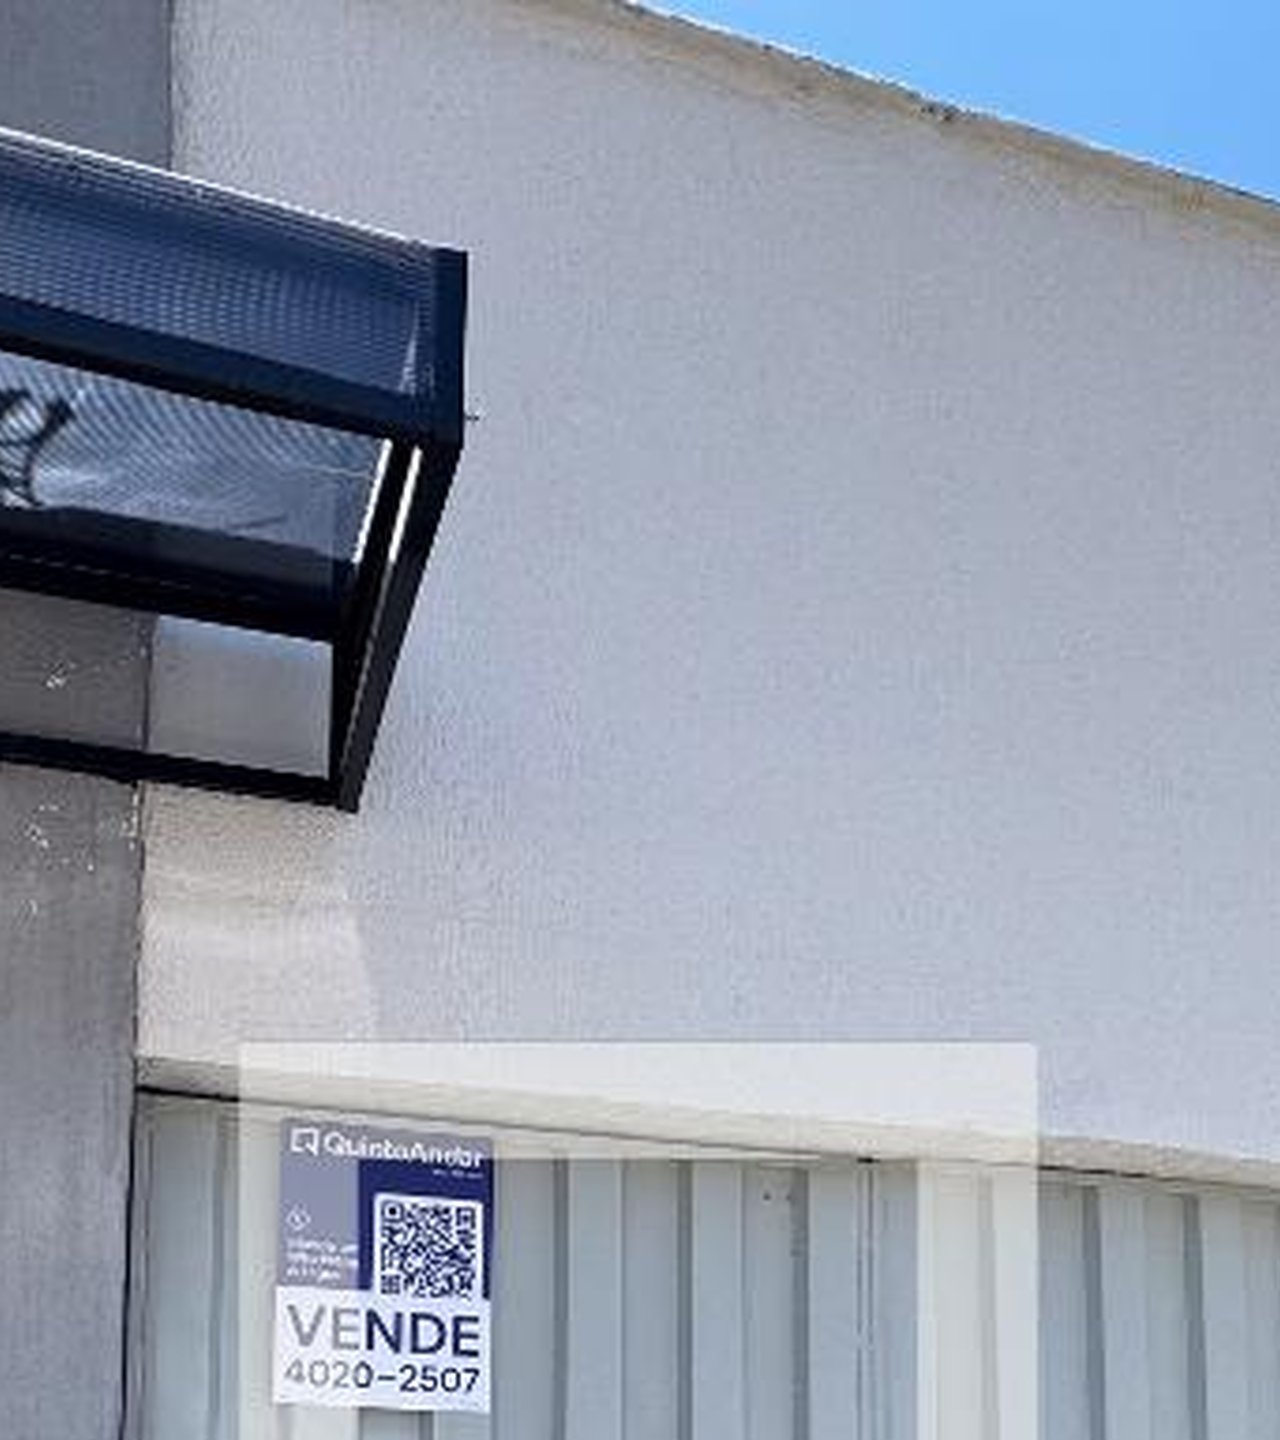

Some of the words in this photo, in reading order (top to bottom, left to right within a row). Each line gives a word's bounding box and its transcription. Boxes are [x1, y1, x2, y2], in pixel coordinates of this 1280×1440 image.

[323, 1131, 484, 1167] QuintoAndar
[287, 1303, 480, 1357] VENDE
[284, 1359, 480, 1392] 4020-2507
